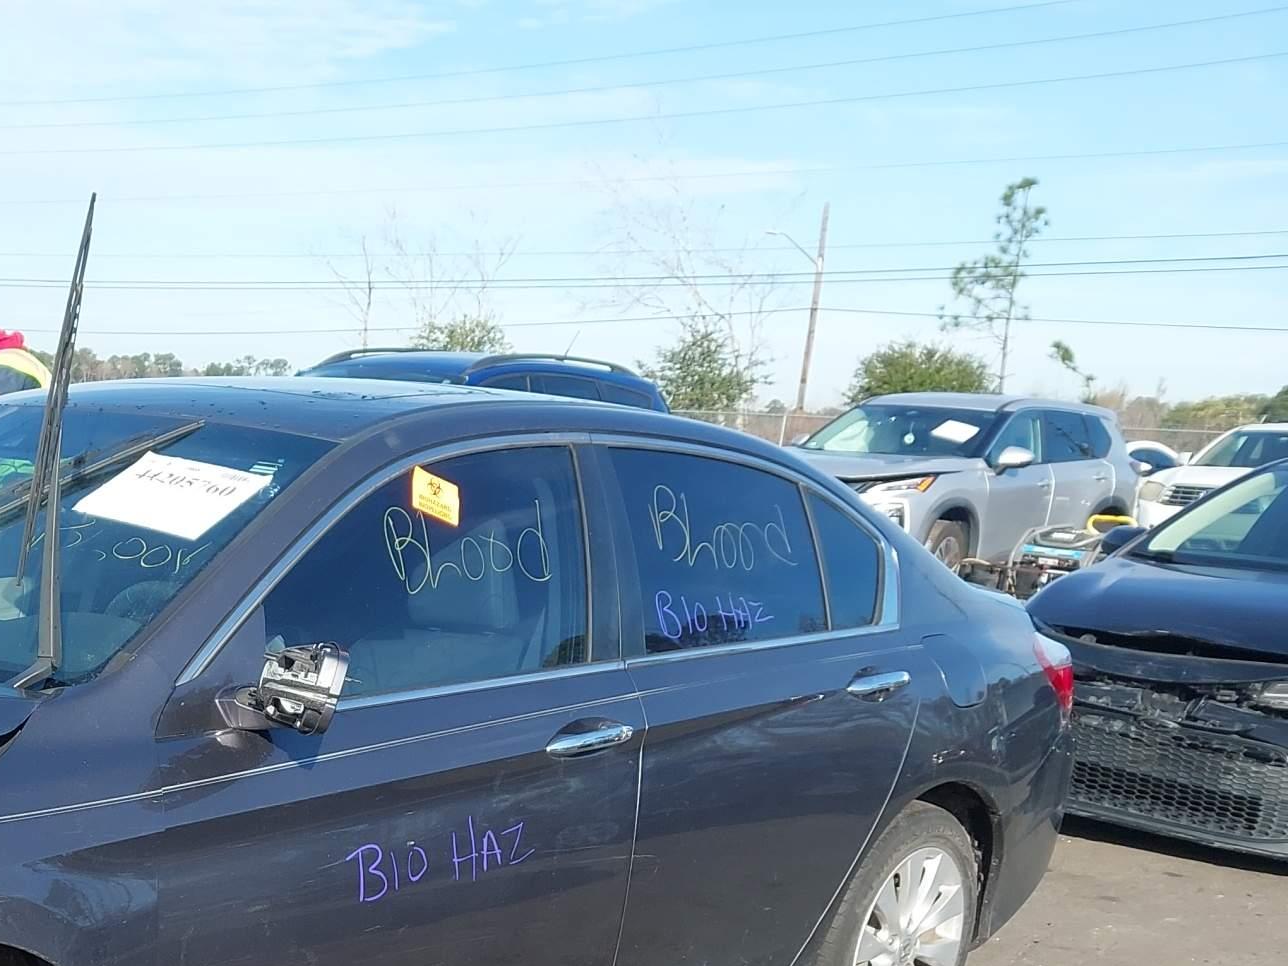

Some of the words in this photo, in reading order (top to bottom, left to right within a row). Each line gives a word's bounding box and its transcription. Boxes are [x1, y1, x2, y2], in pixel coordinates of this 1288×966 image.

[655, 590, 708, 639] BIO
[715, 592, 775, 631] HAZ
[345, 843, 428, 903] BIO
[452, 815, 536, 882] HAZ
